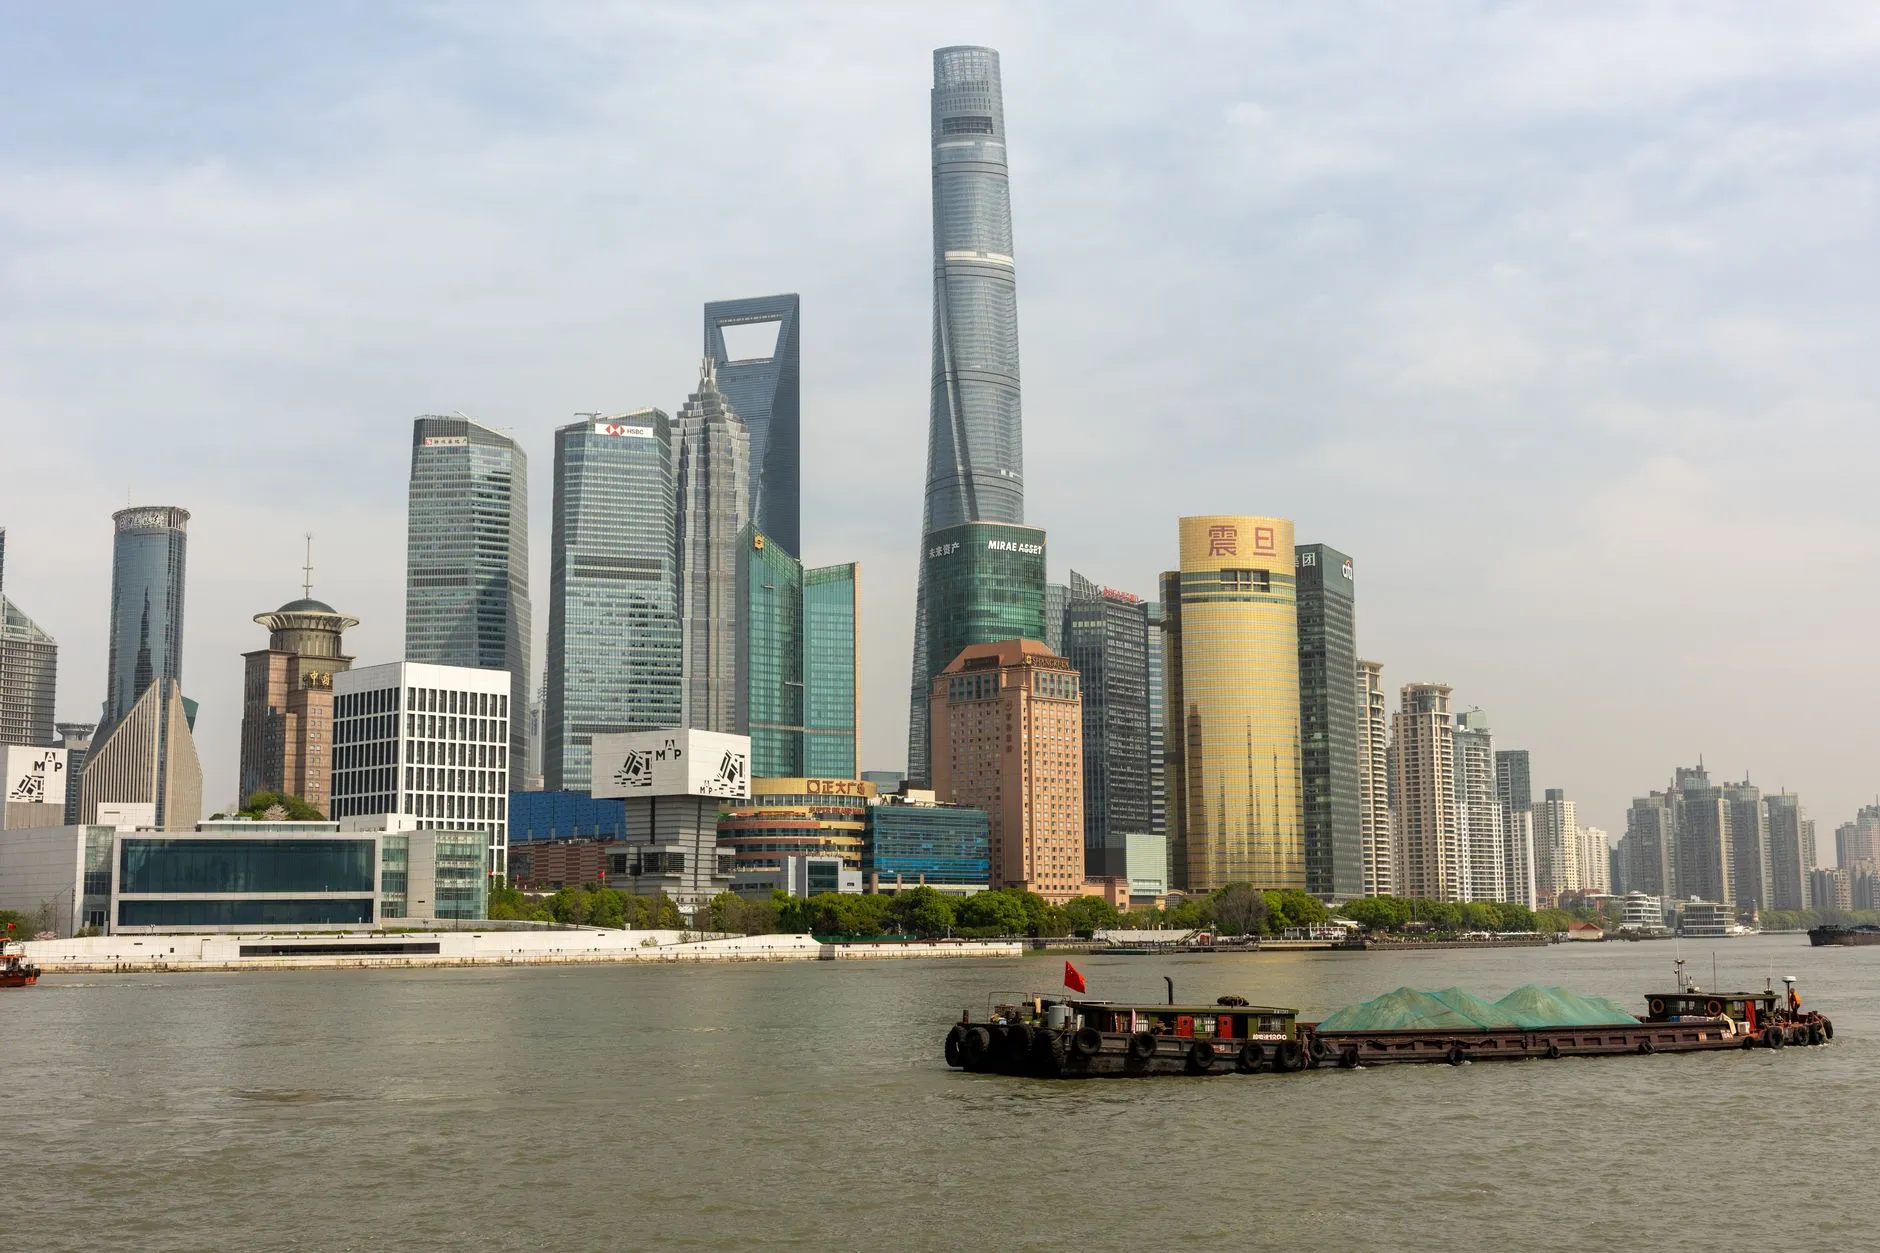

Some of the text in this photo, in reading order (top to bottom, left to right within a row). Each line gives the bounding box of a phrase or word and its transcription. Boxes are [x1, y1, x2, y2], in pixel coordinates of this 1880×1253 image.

[626, 428, 645, 436] HSBC
[928, 541, 961, 560] 未来资产
[988, 540, 1043, 555] MIRAE ASSET
[1208, 525, 1277, 557] 震旦
[655, 739, 682, 761] MAP
[34, 751, 63, 772] MAP
[822, 780, 865, 796] 正大广场
